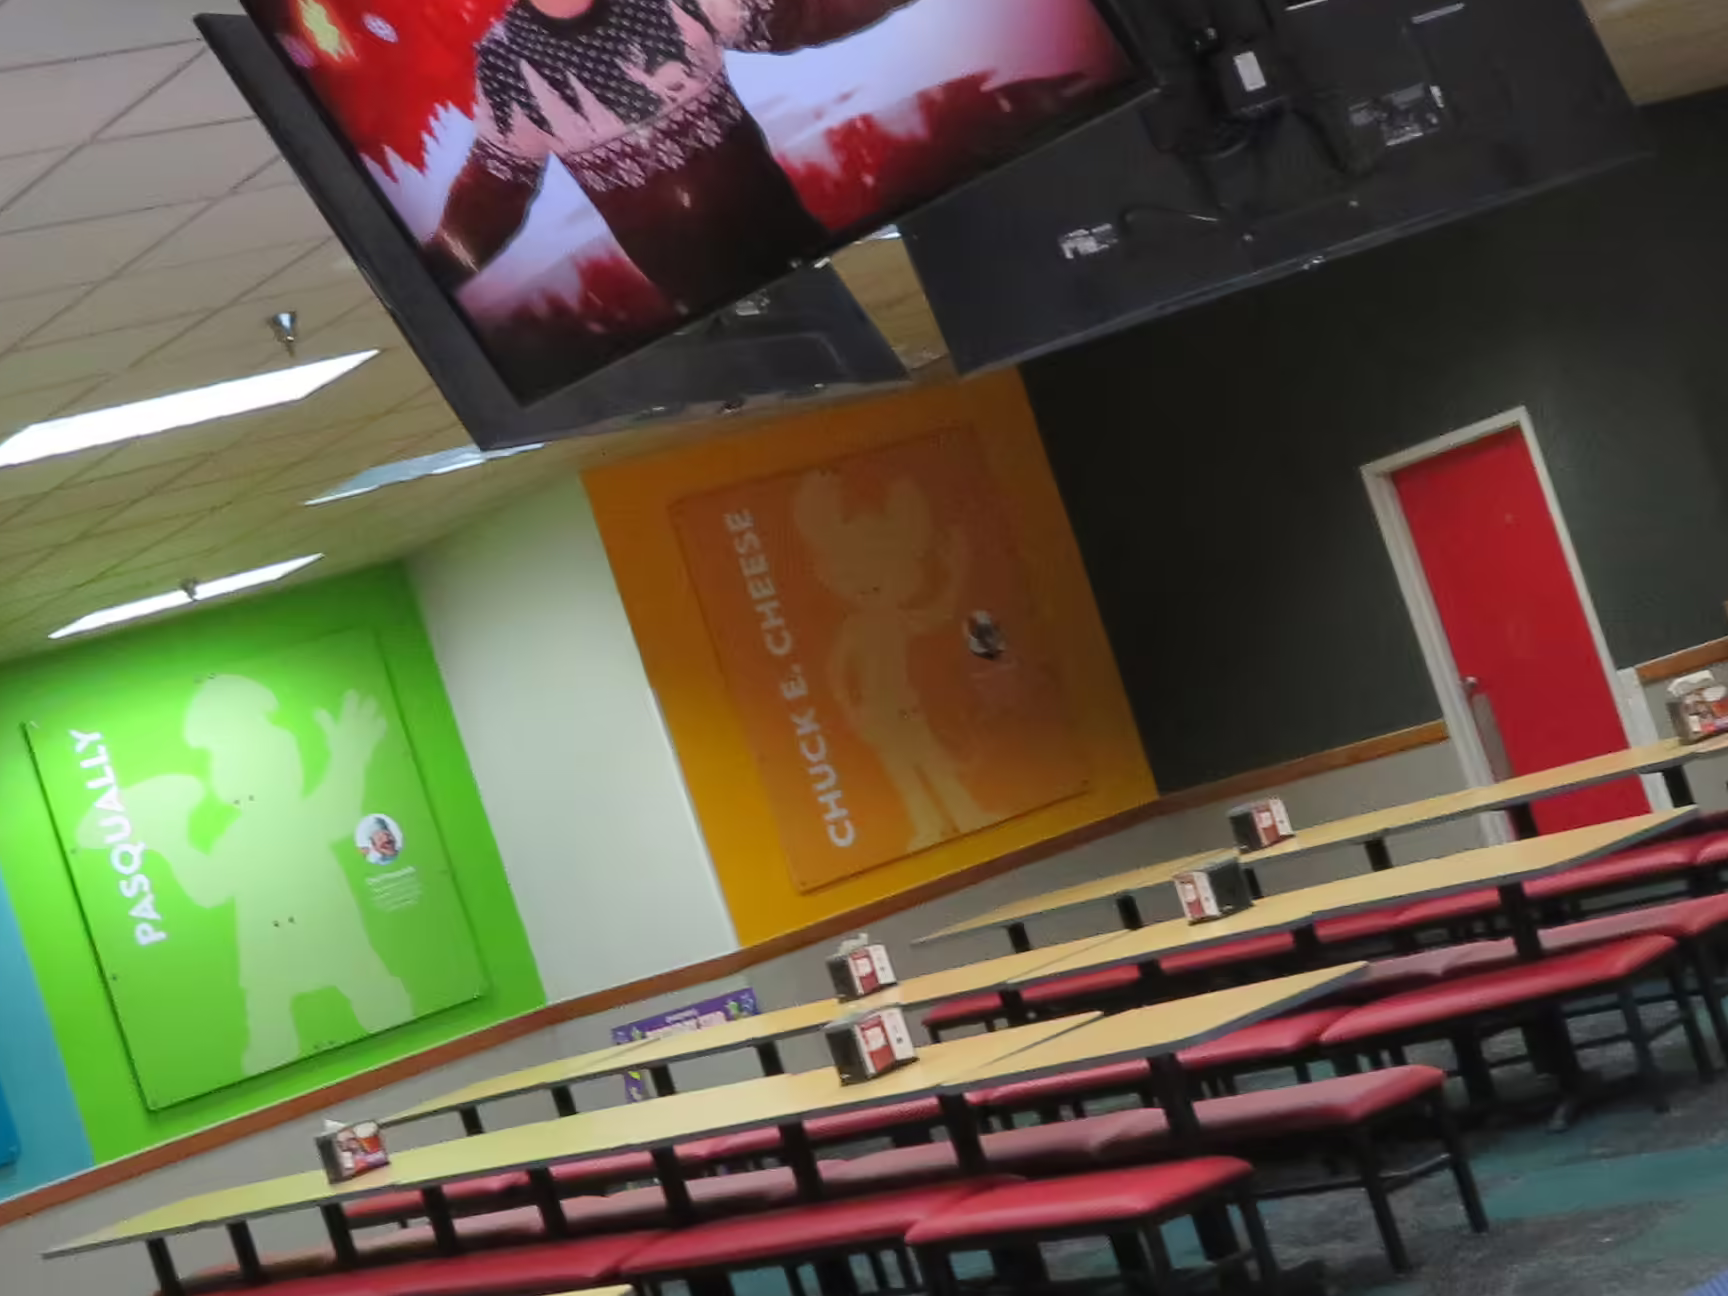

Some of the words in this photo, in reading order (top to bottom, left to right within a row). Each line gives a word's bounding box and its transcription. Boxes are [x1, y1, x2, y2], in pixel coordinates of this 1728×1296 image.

[723, 507, 793, 655] CHEESE
[780, 663, 810, 701] E.
[68, 728, 169, 946] PASQUALLY
[789, 706, 857, 849] CHUCK
